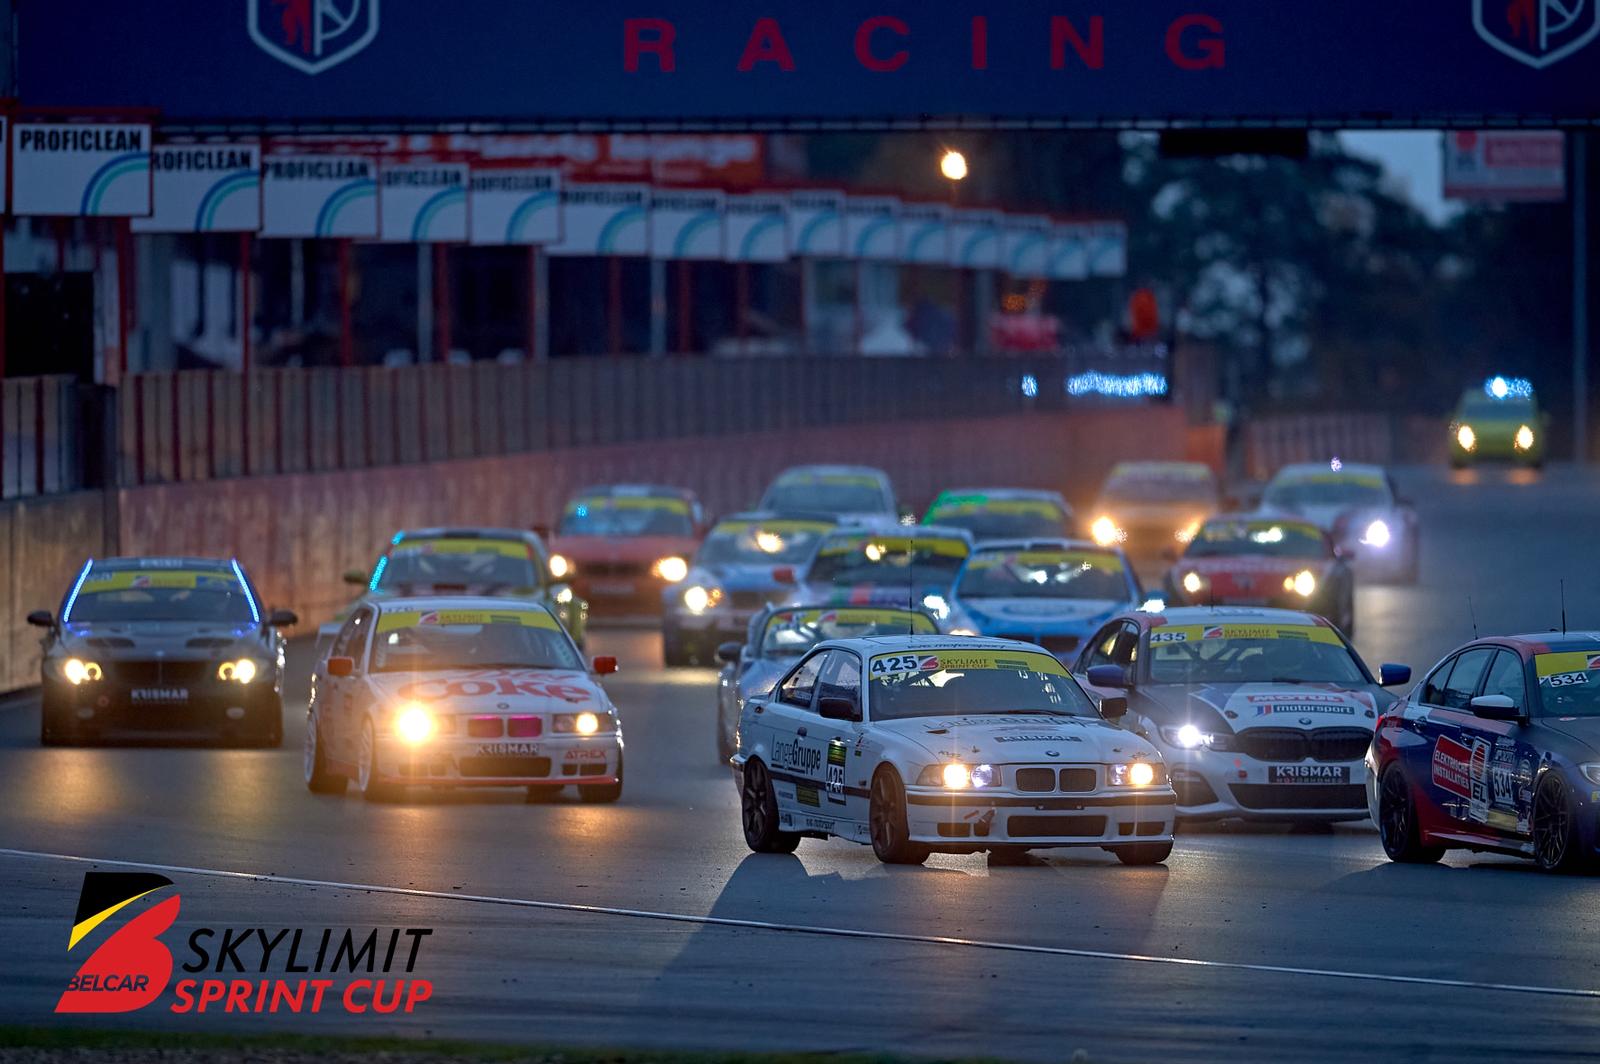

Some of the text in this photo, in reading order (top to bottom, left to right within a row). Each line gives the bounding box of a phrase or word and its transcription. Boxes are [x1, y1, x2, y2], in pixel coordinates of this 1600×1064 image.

[623, 14, 1226, 72] RACING
[20, 129, 141, 151] PROFICLEAN
[1151, 632, 1186, 642] 435
[872, 655, 918, 674] 425
[1550, 673, 1587, 686] 534
[1252, 695, 1343, 703] MOTUL
[1275, 704, 1353, 715] motorsport
[475, 744, 540, 756] KRISMAR
[564, 750, 607, 759] ATREX
[771, 734, 822, 775] LangeGruppe
[1276, 766, 1342, 777] KRISMAR
[826, 766, 844, 794] 425
[1493, 771, 1512, 799] 534
[1473, 782, 1487, 803] EL
